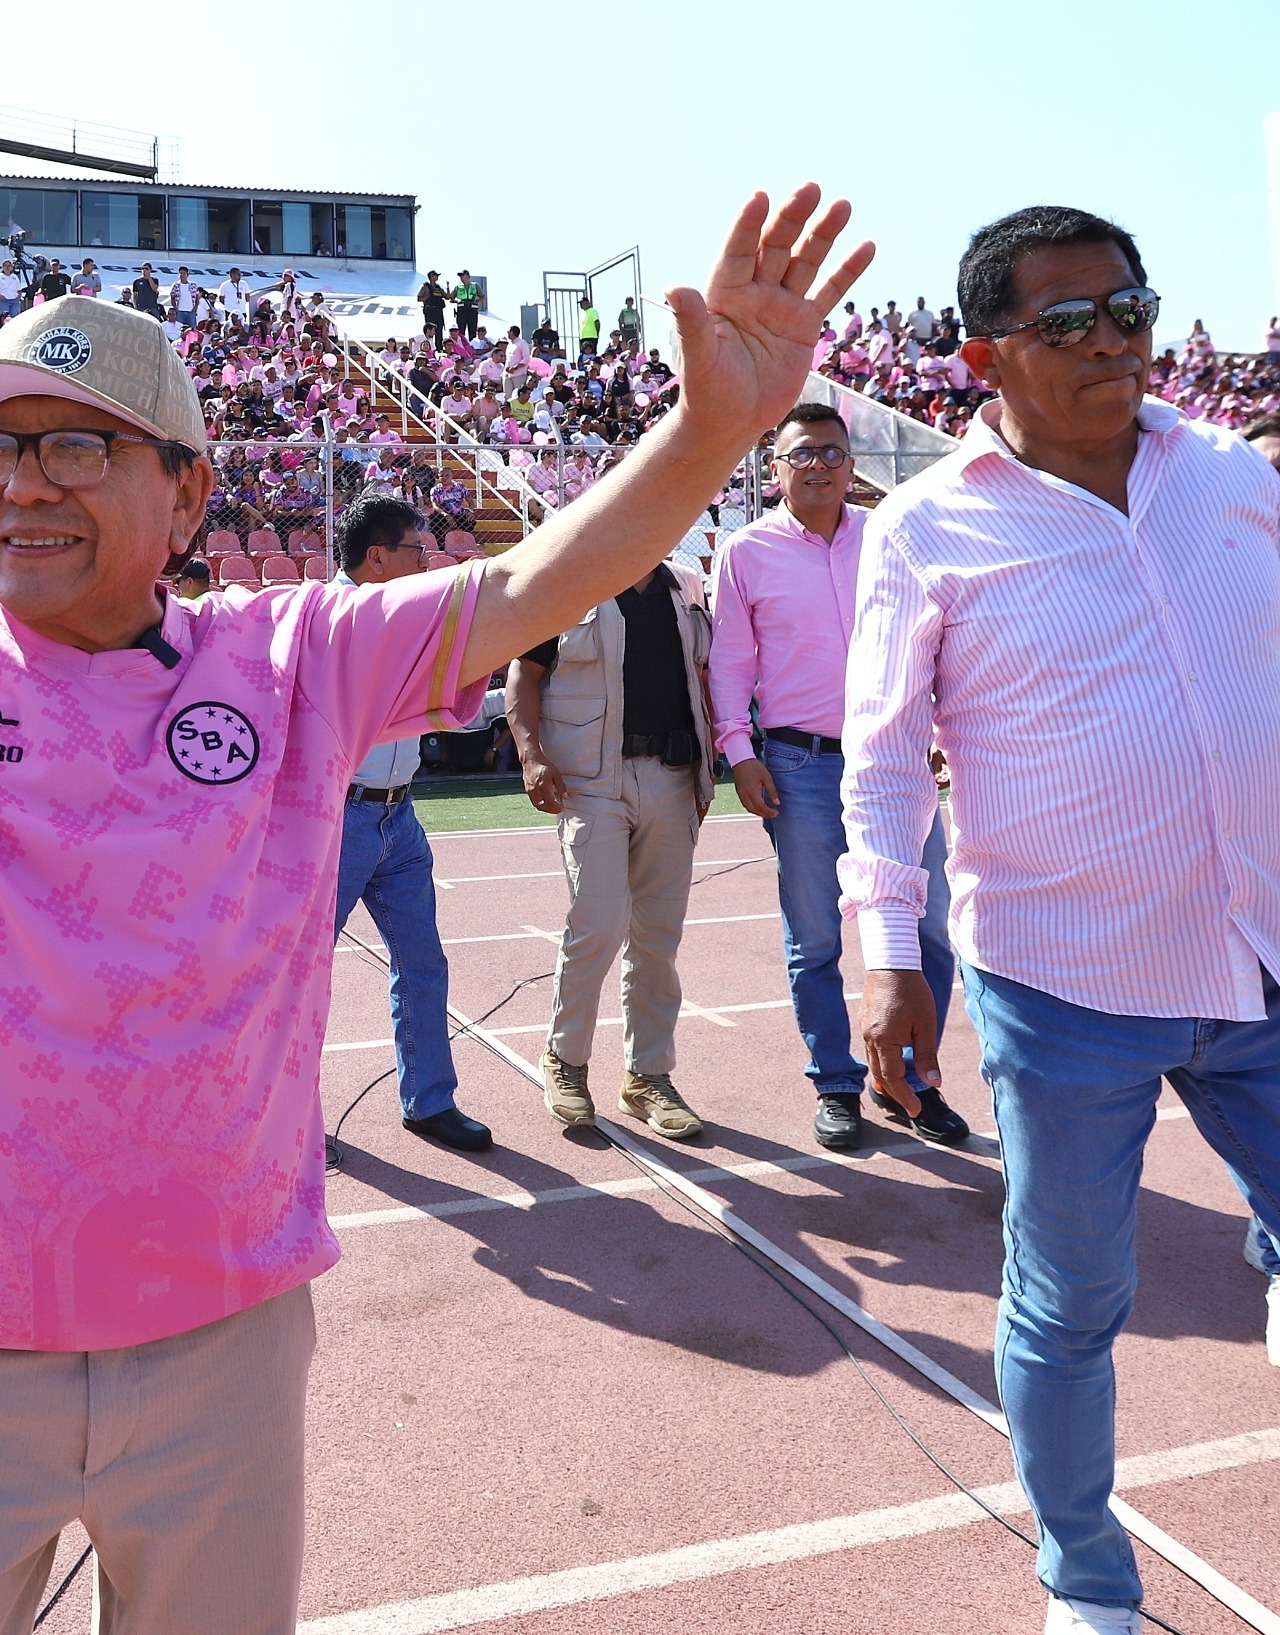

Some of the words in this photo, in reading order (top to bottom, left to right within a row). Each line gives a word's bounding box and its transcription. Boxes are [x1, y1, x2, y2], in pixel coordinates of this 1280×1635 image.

[34, 328, 70, 348] MICHAEL
[71, 330, 90, 350] KORS
[41, 343, 78, 360] MK
[176, 720, 250, 764] SBA
